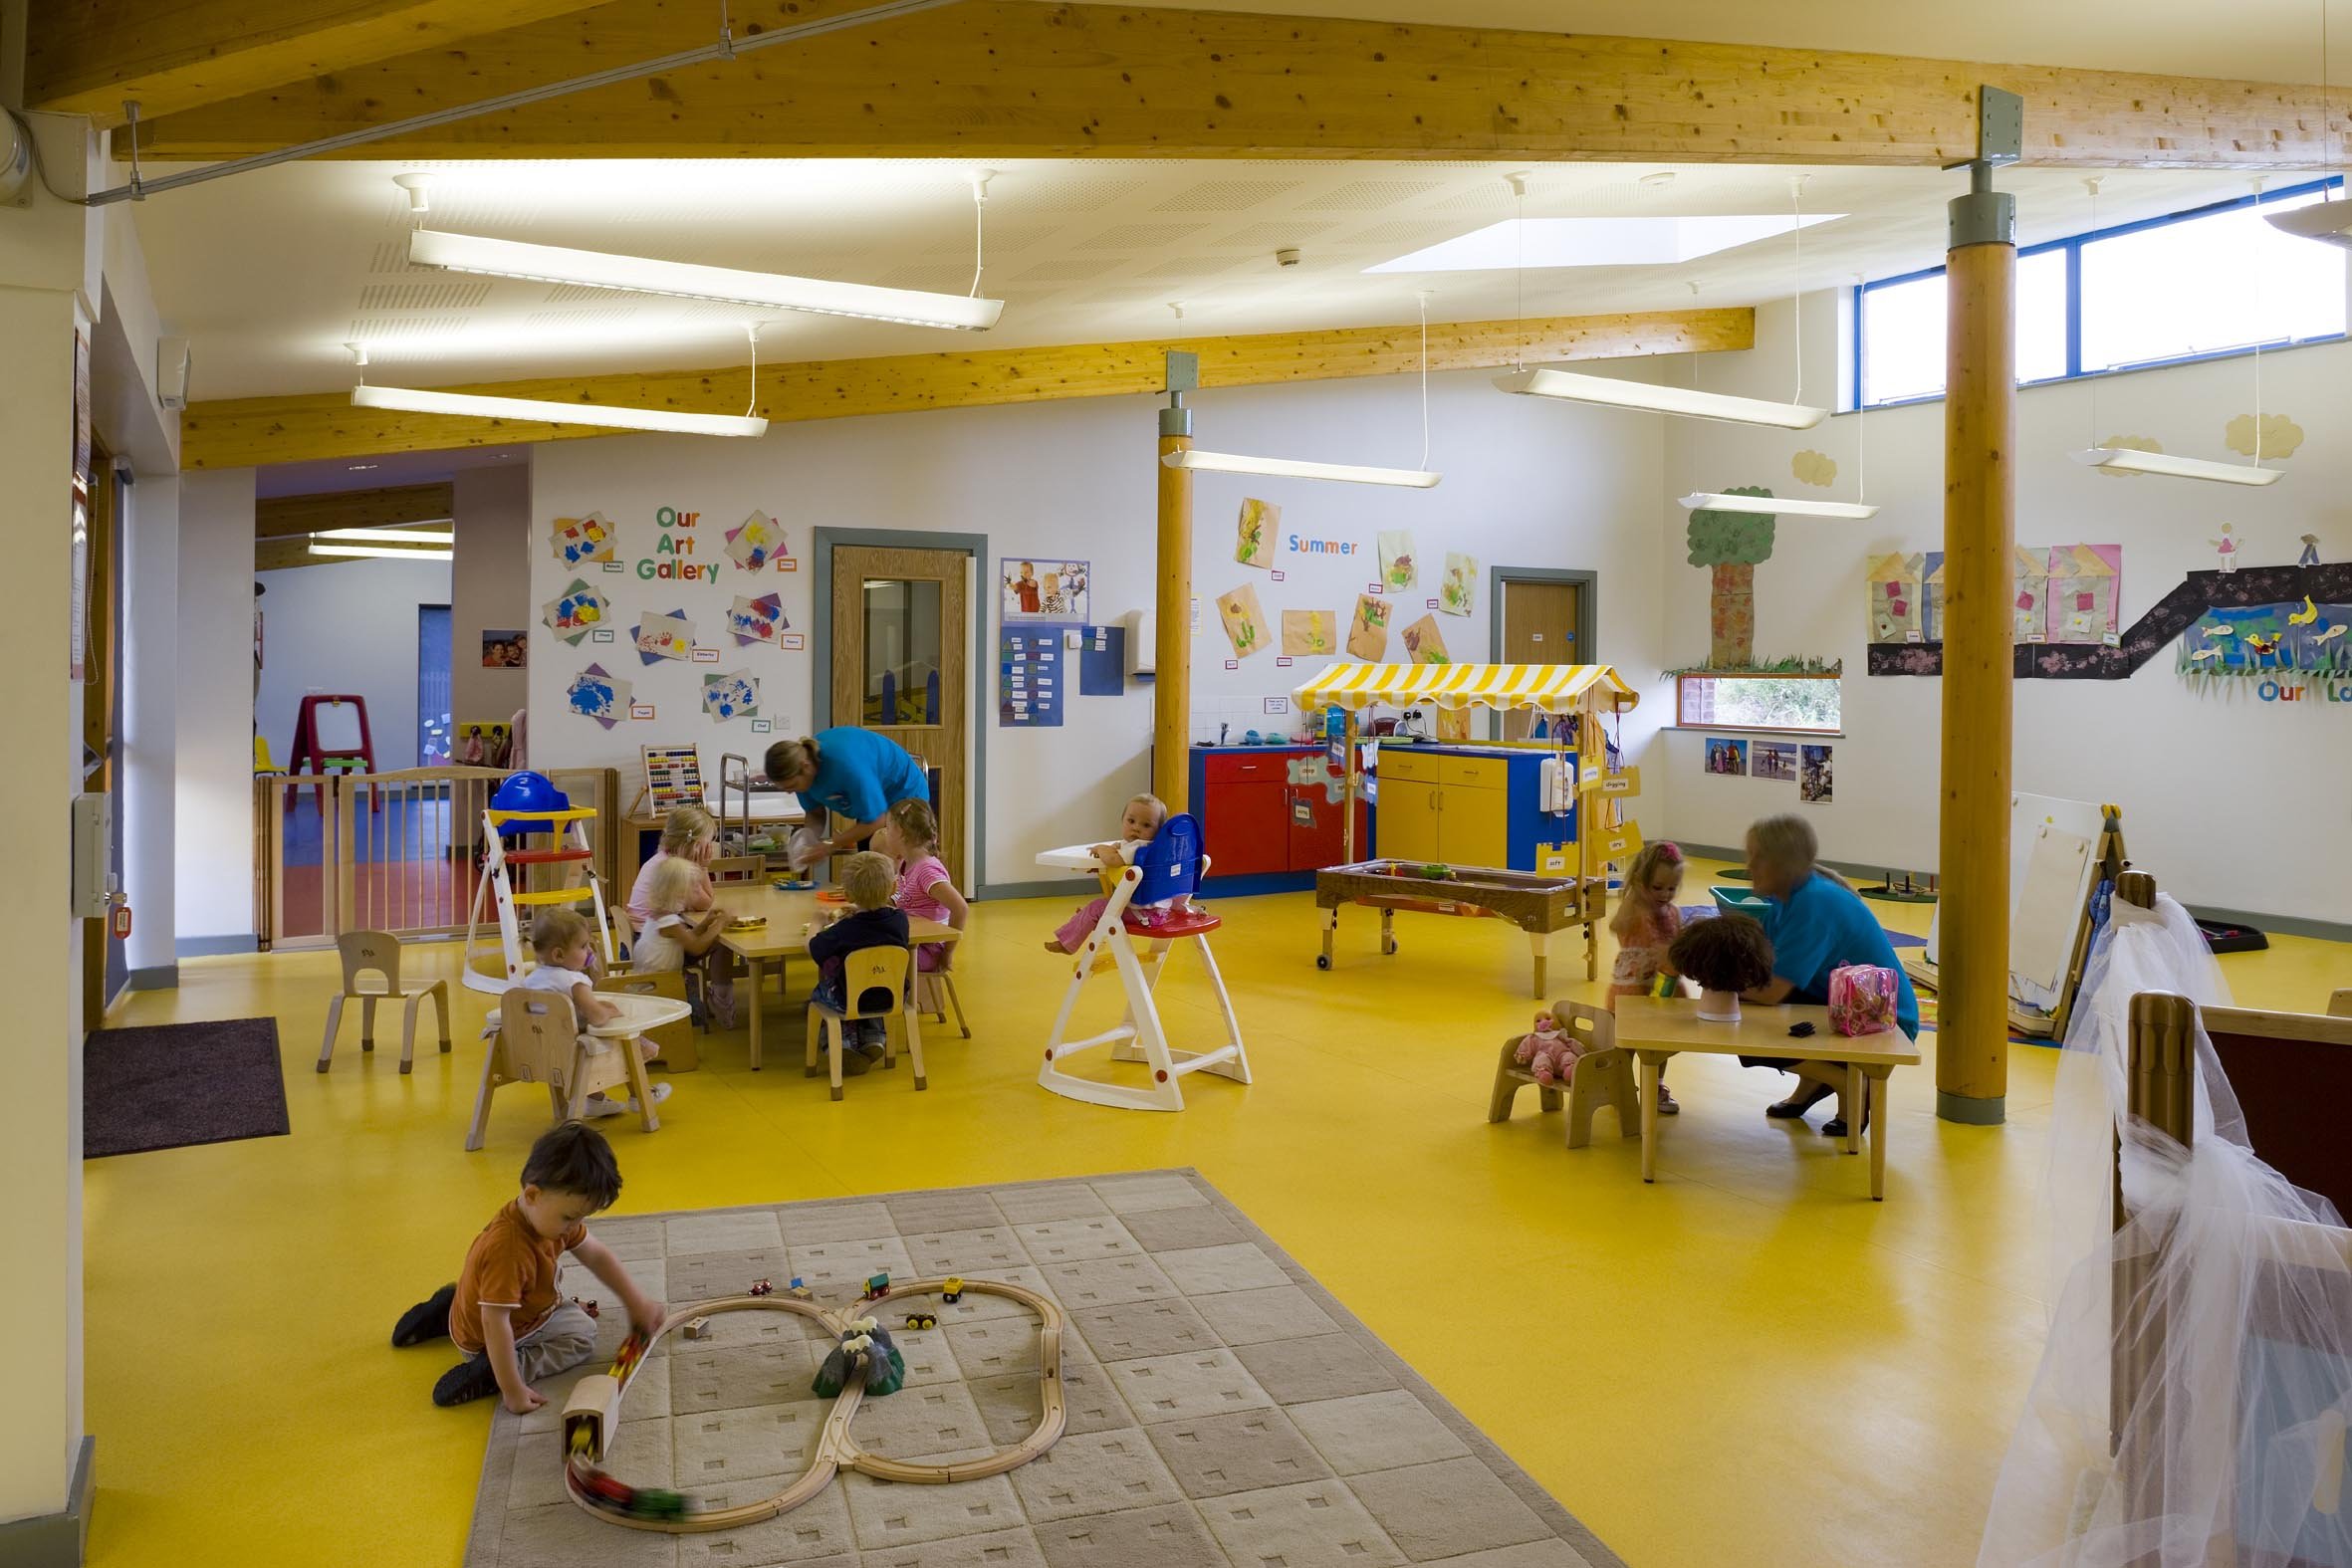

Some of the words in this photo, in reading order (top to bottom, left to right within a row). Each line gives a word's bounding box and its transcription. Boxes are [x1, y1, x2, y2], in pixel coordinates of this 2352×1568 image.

[656, 506, 700, 528] Our
[657, 533, 695, 555] Art
[1290, 535, 1358, 556] Summer
[636, 559, 720, 584] Gallery
[2257, 680, 2306, 702] Our
[1605, 781, 1627, 789] digging
